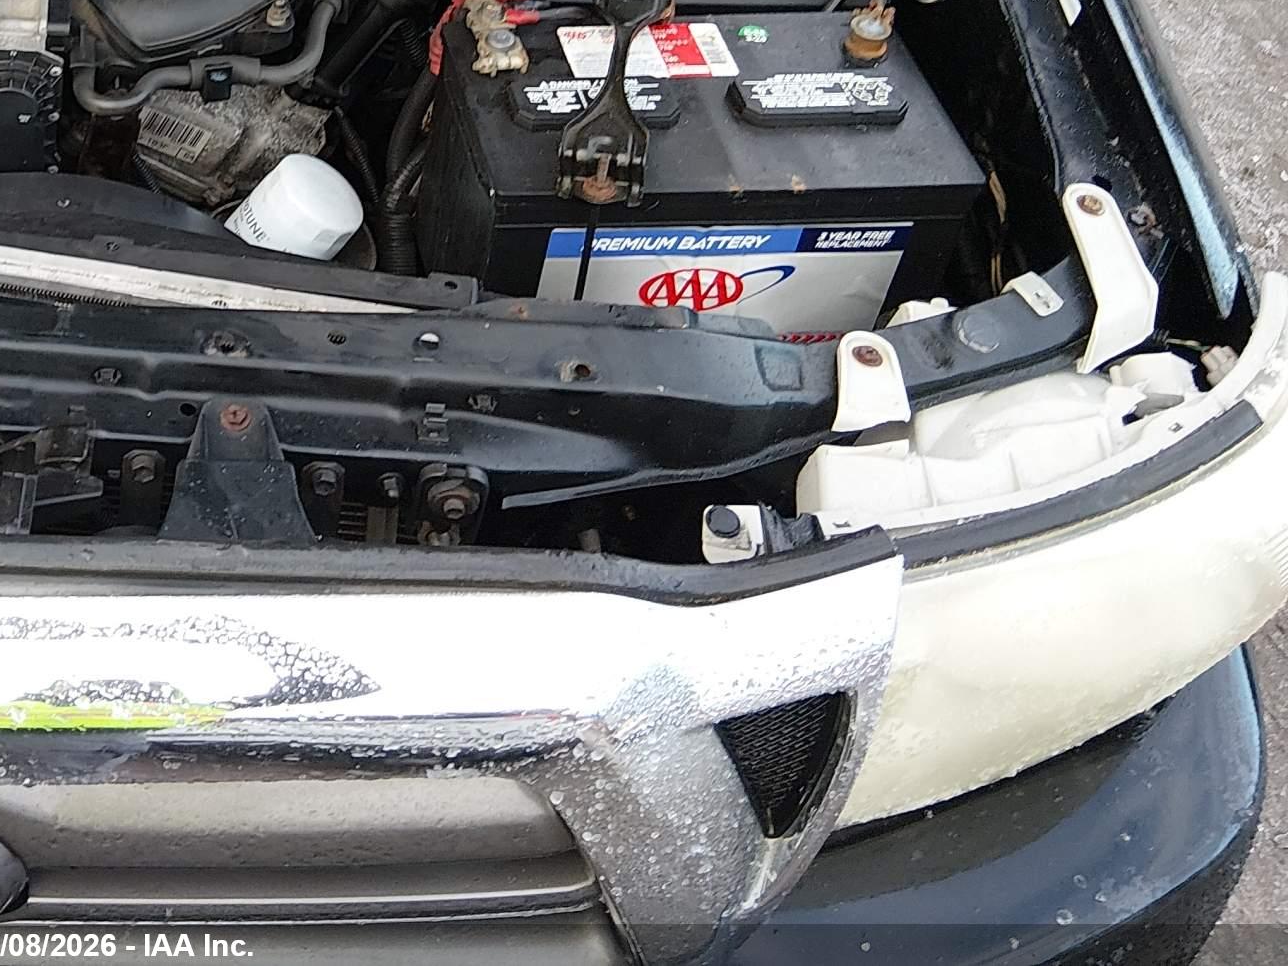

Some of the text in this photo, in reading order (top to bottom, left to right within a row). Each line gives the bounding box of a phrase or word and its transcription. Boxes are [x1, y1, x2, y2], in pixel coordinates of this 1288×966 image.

[828, 231, 862, 241] YEAR
[862, 229, 896, 241] FREE
[676, 234, 772, 251] BATTERY
[814, 238, 892, 249] REPLACEMENT
[639, 268, 744, 312] AAA
